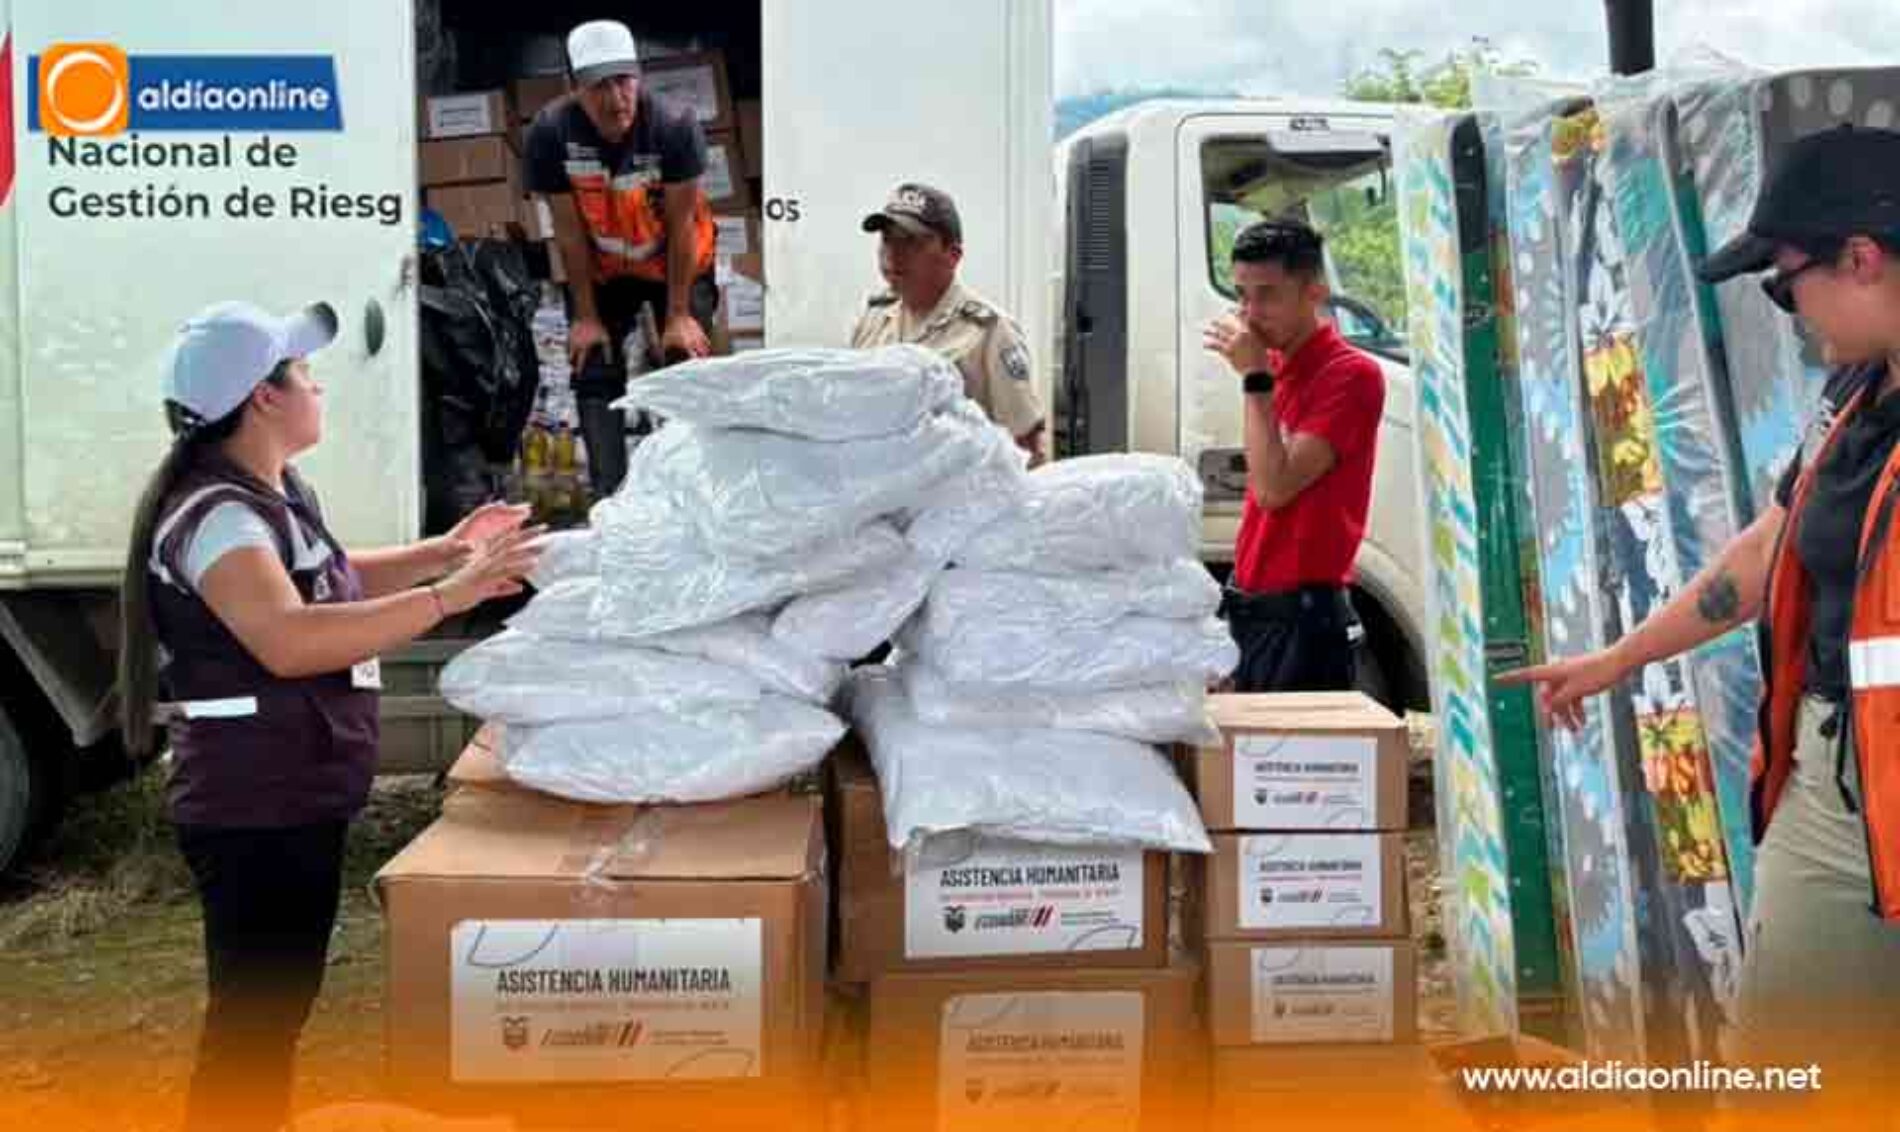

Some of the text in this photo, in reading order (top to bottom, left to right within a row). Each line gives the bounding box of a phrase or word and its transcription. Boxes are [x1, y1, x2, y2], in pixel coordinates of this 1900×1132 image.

[49, 134, 298, 167] Nacional de
[49, 184, 403, 225] Gestión de Riesg
[940, 862, 1121, 888] ASISTENCIA HUMANITARIA
[497, 967, 730, 994] ASISTENCIA HUMANITARIA
